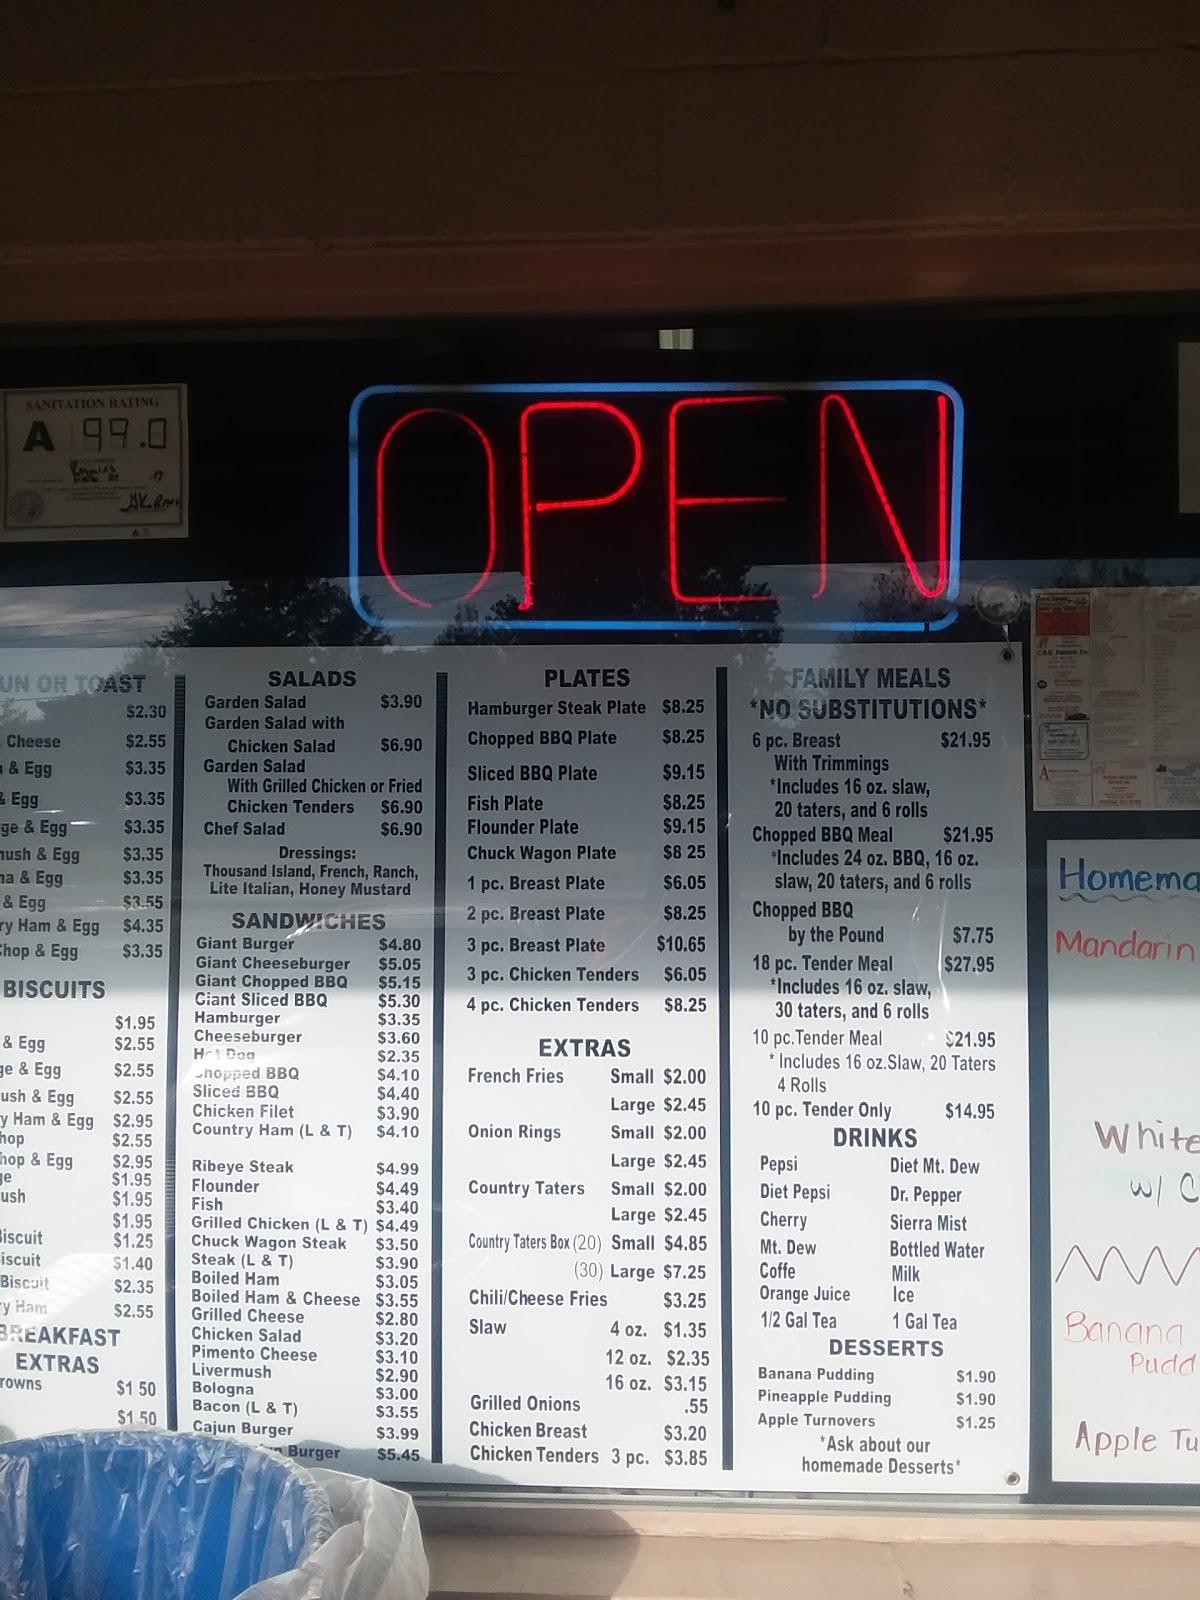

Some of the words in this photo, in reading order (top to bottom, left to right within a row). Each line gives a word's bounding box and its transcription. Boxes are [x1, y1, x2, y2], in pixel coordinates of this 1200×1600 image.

[25, 398, 105, 411] SANITATION
[109, 397, 159, 409] RATING
[23, 420, 55, 452] A
[375, 393, 948, 610] OPEN
[75, 673, 147, 695] TOAST
[267, 670, 357, 688] SALADS
[544, 667, 631, 688] PLATES
[792, 667, 870, 689] FAMILY
[876, 666, 951, 689] MEALS
[126, 703, 167, 719] $2.30
[204, 694, 260, 710] Garden
[264, 694, 307, 709] Salad
[380, 693, 423, 710] $3.90
[467, 700, 554, 719] Hamburger
[557, 699, 602, 715] Steak
[607, 699, 647, 715] Plate
[662, 698, 705, 715] $8.25
[6, 733, 61, 749] Cheese
[125, 733, 167, 750] $2.55
[227, 738, 288, 754] Chicken
[293, 738, 336, 754] Salad
[380, 737, 423, 753] $6.90
[752, 731, 761, 748] 6
[765, 735, 788, 753] pc.
[792, 731, 841, 749] Breast
[940, 730, 991, 750] $21.95
[773, 754, 808, 772] With
[811, 754, 890, 776] Trimmings
[227, 777, 258, 794] With
[262, 777, 308, 794] Grilled
[311, 777, 366, 794] Chicken
[370, 781, 385, 794] or
[388, 777, 423, 794] Fried
[774, 800, 793, 818] 20
[796, 801, 846, 822] taters,
[850, 800, 877, 818] and
[881, 800, 891, 818] 6
[895, 800, 928, 818] rolls
[203, 821, 240, 836] Chef
[242, 821, 286, 836] Salad
[380, 821, 423, 838] $6.90
[752, 825, 817, 847] Chopped
[821, 825, 854, 844] BBQ
[858, 826, 893, 843] Meal
[943, 825, 994, 846] $21.95
[279, 845, 356, 863] Dressings:
[203, 863, 268, 878] Thousand
[271, 863, 316, 881] Island,
[319, 864, 369, 881] French,
[373, 864, 419, 882] Ranch,
[209, 881, 239, 895] Lite
[243, 881, 294, 898] Italian,
[299, 881, 347, 899] Honey
[350, 882, 411, 896] Mustard
[467, 875, 475, 891] 1
[481, 879, 504, 894] pc.
[509, 875, 561, 891] Breast
[565, 875, 606, 891] Plate
[663, 874, 707, 891] $6.05
[18, 917, 51, 933] Ham
[56, 918, 67, 933] &
[72, 918, 100, 937] Egg
[123, 917, 164, 934] $4.35
[231, 911, 387, 932] SANDWICHES
[656, 934, 706, 953] $10.65
[1055, 930, 1194, 962] Mandarin
[3, 979, 106, 1000] BISCUITS
[115, 1014, 156, 1031] $1.95
[194, 1010, 281, 1027] Hamburger
[377, 1012, 421, 1027] $3.35
[2, 1034, 13, 1049] &
[18, 1035, 46, 1054] Egg
[114, 1036, 155, 1052] $2.55
[539, 1038, 631, 1058] EXTRAS
[468, 1067, 521, 1084] French
[526, 1067, 564, 1084] Fries
[610, 1067, 654, 1084] Small
[663, 1067, 707, 1086] $2.00
[13, 1111, 46, 1126] Ham
[51, 1112, 62, 1127] &
[67, 1112, 94, 1131] Egg
[113, 1113, 154, 1129] $2.95
[833, 1127, 918, 1149] DRINKS
[759, 1154, 799, 1175] Pepsi
[890, 1156, 919, 1174] Diet
[923, 1157, 945, 1174] Mt.
[949, 1157, 980, 1175] Dew
[191, 1178, 261, 1195] Flounder
[376, 1180, 419, 1197] $4.49
[468, 1179, 530, 1199] Country
[534, 1180, 585, 1196] Taters
[611, 1181, 654, 1196] Small
[664, 1181, 707, 1197] $2.00
[191, 1196, 223, 1211] Fish
[375, 1199, 419, 1215] $3.40
[890, 1213, 933, 1231] Sierra
[937, 1214, 967, 1232] Mist
[468, 1232, 510, 1254] Country
[514, 1233, 547, 1250] Taters
[550, 1233, 571, 1251] Box
[572, 1233, 603, 1255] (20)
[611, 1234, 655, 1251] Small
[664, 1234, 708, 1252] $4.85
[890, 1240, 940, 1258] Bottled
[944, 1241, 985, 1259] Water
[759, 1261, 797, 1280] Coffe
[892, 1264, 921, 1282] Milk
[469, 1288, 564, 1306] Chili/Cheese
[569, 1290, 608, 1307] Fries
[663, 1291, 707, 1309] $3.25
[759, 1284, 809, 1305] Orange
[813, 1285, 851, 1302] Juice
[893, 1285, 915, 1303] Ice
[114, 1303, 154, 1319] $2.55
[469, 1318, 507, 1335] Slaw
[610, 1320, 621, 1337] 4
[624, 1324, 648, 1338] oz.
[663, 1321, 707, 1339] $1.35
[1064, 1310, 1183, 1345] Banana
[191, 1344, 255, 1360] Pimento
[260, 1346, 318, 1362] Cheese
[375, 1349, 419, 1365] $3.10
[829, 1338, 944, 1357] DESSERTS
[15, 1352, 100, 1375] EXTRAS
[192, 1362, 272, 1379] Livermush
[375, 1367, 419, 1383] $2.90
[758, 1366, 812, 1380] Banana
[817, 1367, 875, 1385] Pudding
[956, 1369, 996, 1384] $1.90
[192, 1380, 254, 1398] Bologna
[375, 1386, 419, 1401] $3.00
[470, 1394, 522, 1411] Grilled
[527, 1395, 581, 1412] Onions
[683, 1397, 709, 1415] .55
[757, 1412, 799, 1429] Apple
[803, 1413, 876, 1428] Turnovers
[956, 1415, 996, 1430] $1.25
[1075, 1420, 1157, 1458] Apple
[287, 1444, 342, 1462] Burger
[376, 1446, 421, 1463] $5.45
